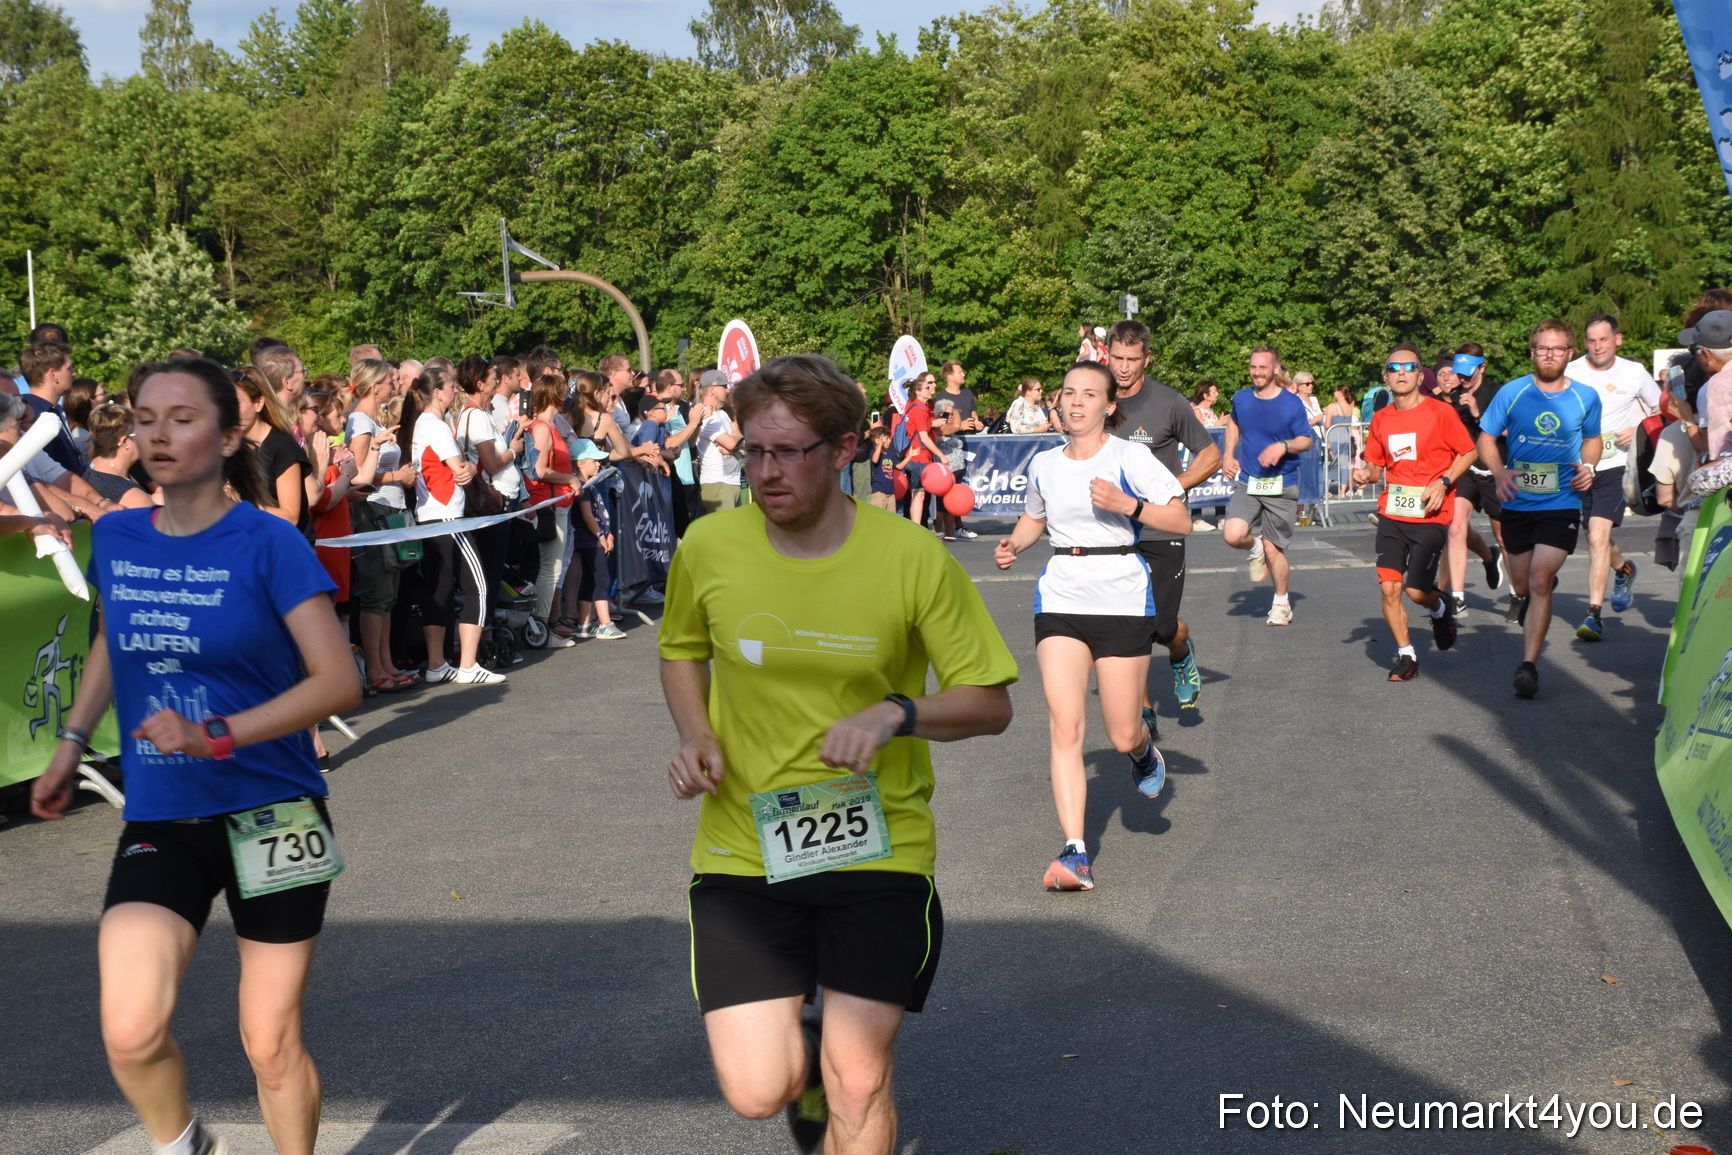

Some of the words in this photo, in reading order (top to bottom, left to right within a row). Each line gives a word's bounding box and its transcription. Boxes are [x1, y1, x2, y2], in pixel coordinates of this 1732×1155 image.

[1605, 441, 1612, 450] 0
[972, 469, 1028, 492] che
[1255, 482, 1275, 490] 867
[1523, 473, 1547, 485] 987
[975, 494, 1028, 504] MOBIL
[1394, 496, 1416, 508] 528
[111, 559, 161, 580] Wenn
[162, 568, 183, 582] es
[184, 564, 231, 582] beim
[110, 583, 225, 607] Hausverkauf
[129, 608, 191, 631] richtig
[118, 632, 201, 655] LAUFEN
[773, 800, 820, 816] firmenlauf
[849, 794, 872, 806] 2019
[775, 805, 868, 853] 1225
[259, 830, 326, 867] 730
[784, 849, 819, 864] Gindler
[821, 838, 868, 856] Alexander
[798, 856, 827, 868] Klinikum
[828, 850, 858, 862] Neumarkt
